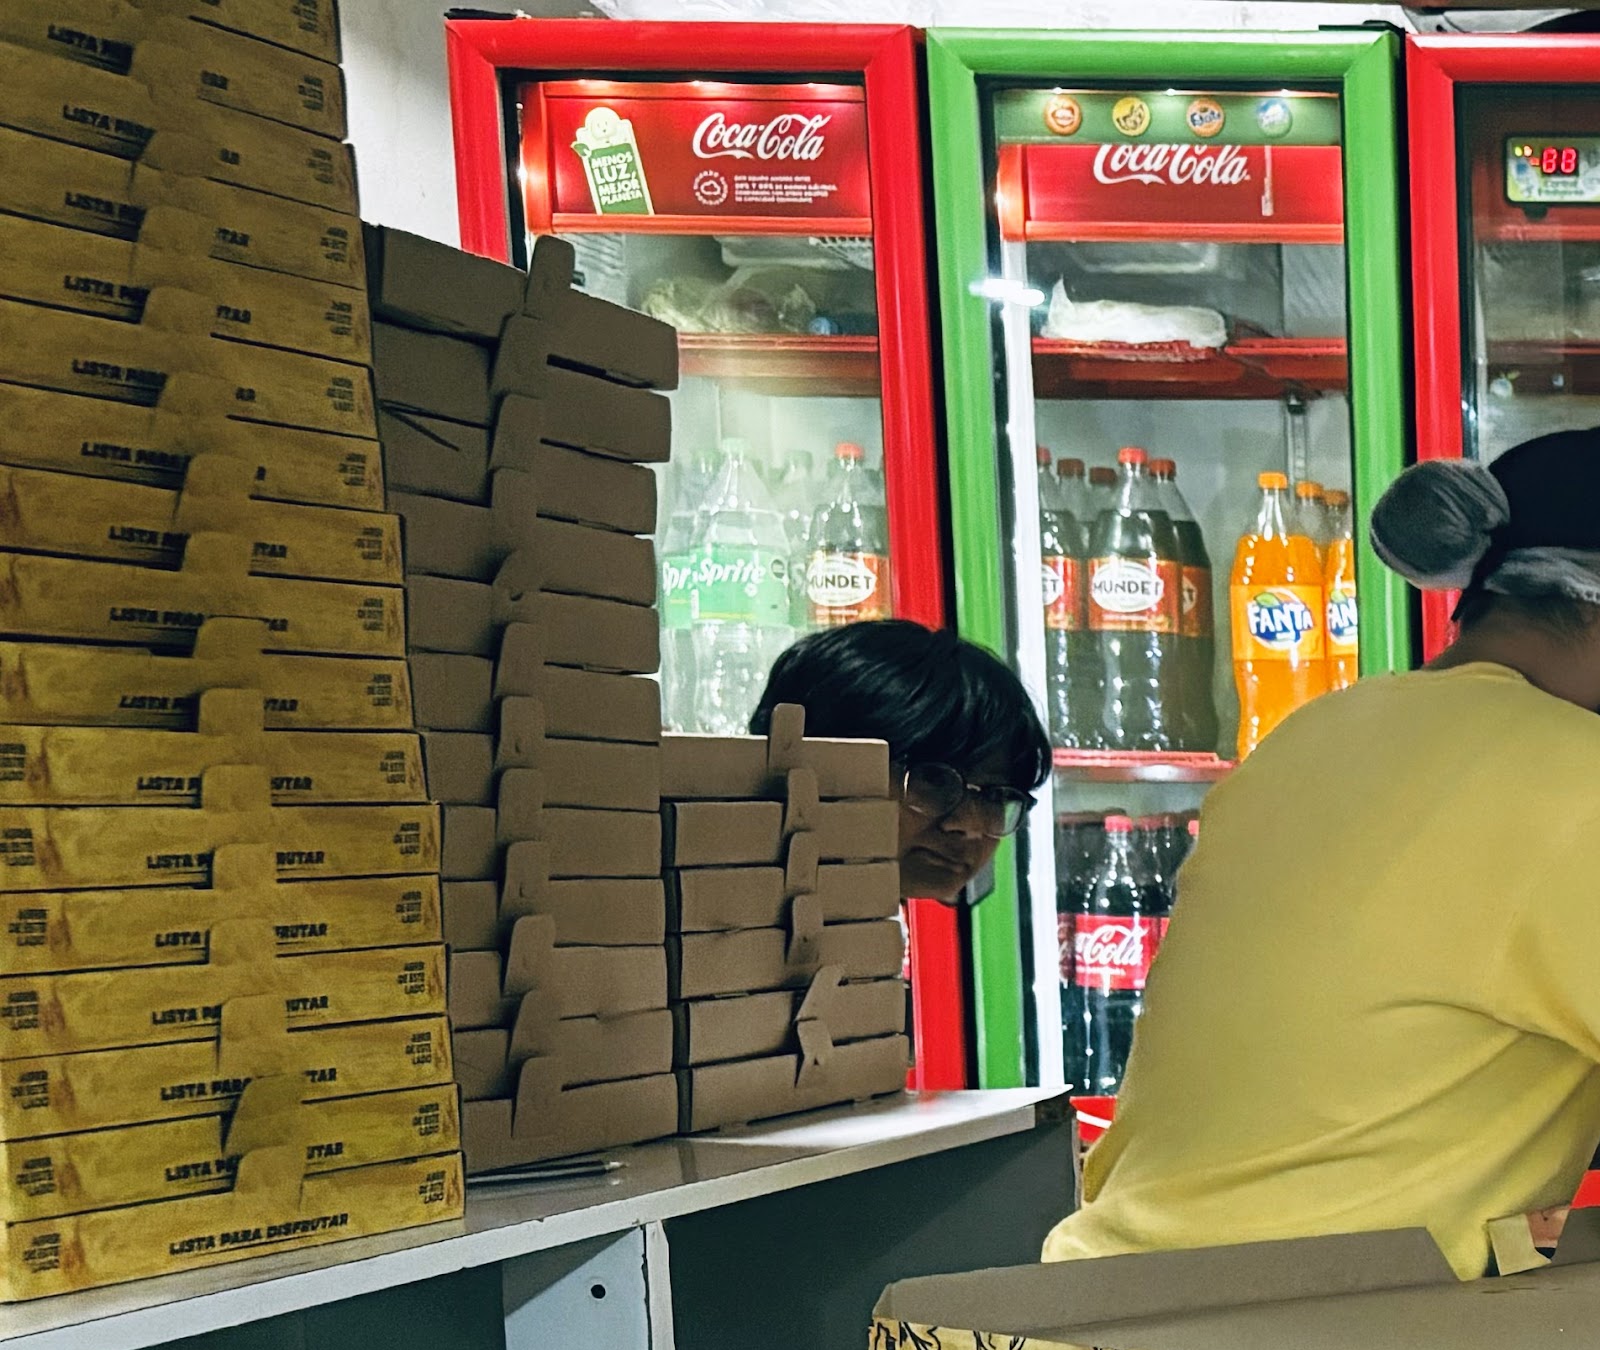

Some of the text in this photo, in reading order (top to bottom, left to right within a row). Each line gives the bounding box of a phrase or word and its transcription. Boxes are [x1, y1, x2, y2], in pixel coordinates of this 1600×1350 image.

[591, 151, 633, 168] MENOS
[598, 178, 640, 195] MEJOR
[601, 190, 643, 206] PLANETA
[699, 557, 766, 587] Sprite
[1247, 600, 1314, 634] FANTA
[1327, 598, 1358, 631] FAN
[137, 776, 184, 790] LISTA
[147, 853, 193, 869] LISTA
[155, 931, 201, 947] LISTA
[152, 1007, 197, 1025] LISTA
[161, 1081, 207, 1101] LISTA
[165, 1162, 211, 1181] LISTA
[169, 1213, 348, 1255] LISTA PARA DISFRUTAR
